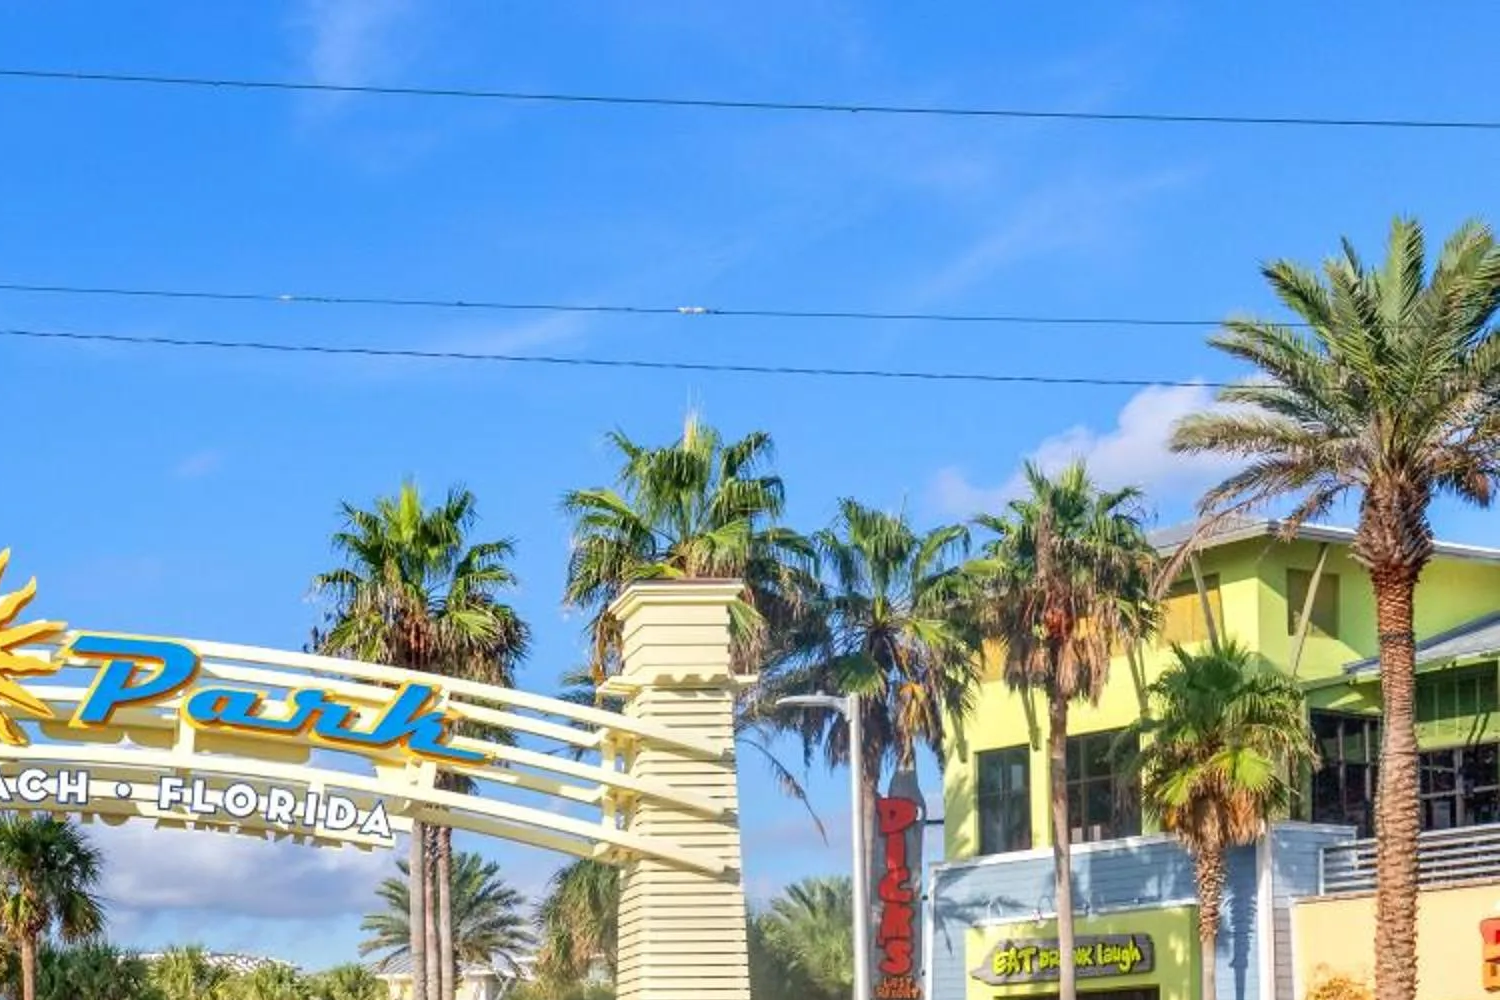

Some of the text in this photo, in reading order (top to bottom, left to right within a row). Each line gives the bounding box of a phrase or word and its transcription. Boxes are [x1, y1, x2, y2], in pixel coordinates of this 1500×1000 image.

[68, 633, 494, 763] Park
[158, 775, 395, 839] FLORIDA
[992, 947, 1037, 976] EAT
[1097, 937, 1142, 974] laugh
